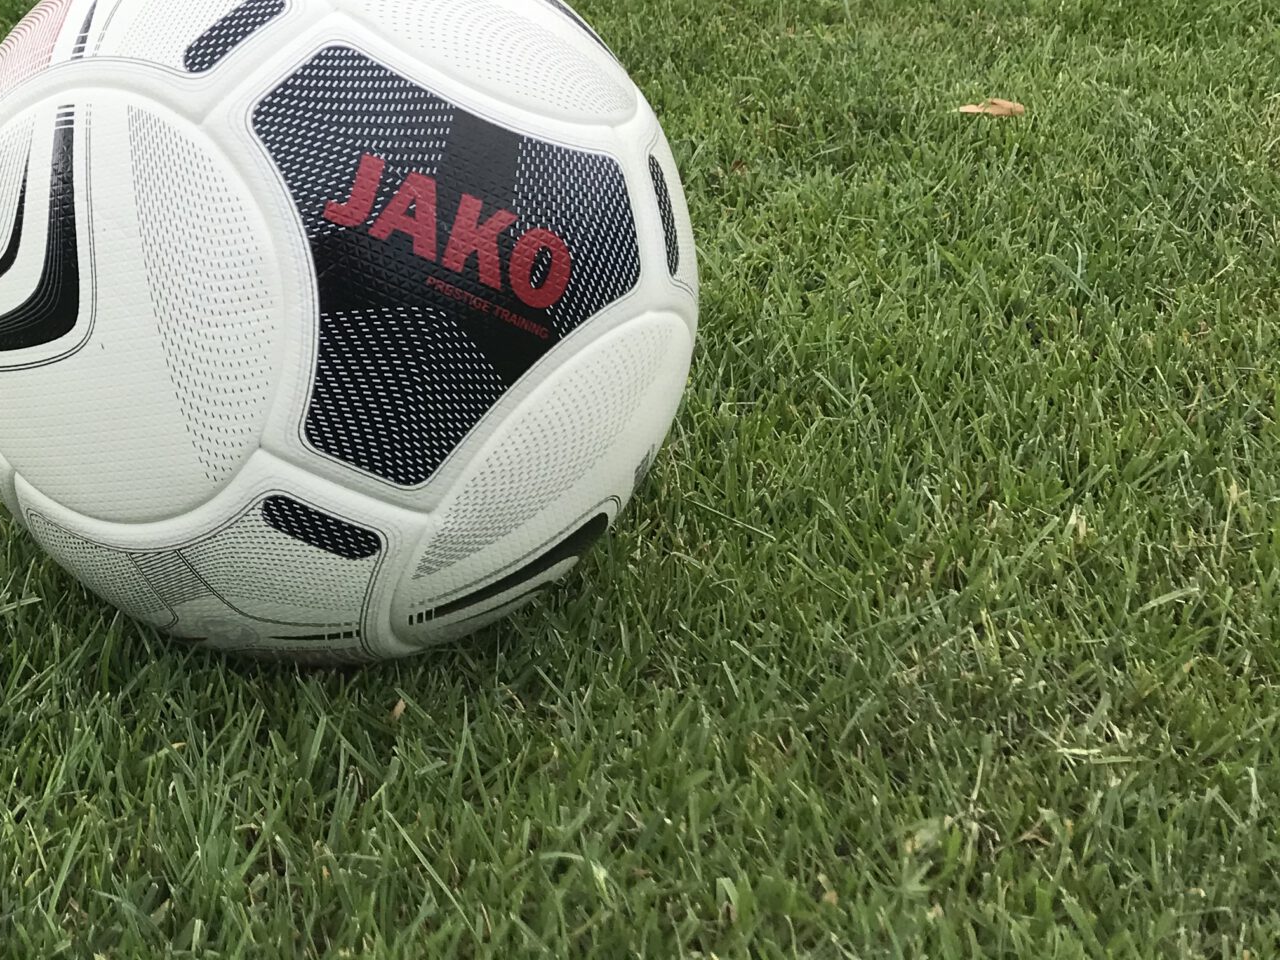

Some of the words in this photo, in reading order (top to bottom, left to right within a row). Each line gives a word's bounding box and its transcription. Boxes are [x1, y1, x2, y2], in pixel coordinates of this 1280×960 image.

[323, 152, 571, 308] JAKO
[426, 276, 492, 313] PRESTIGE
[494, 304, 549, 339] TRAINING
